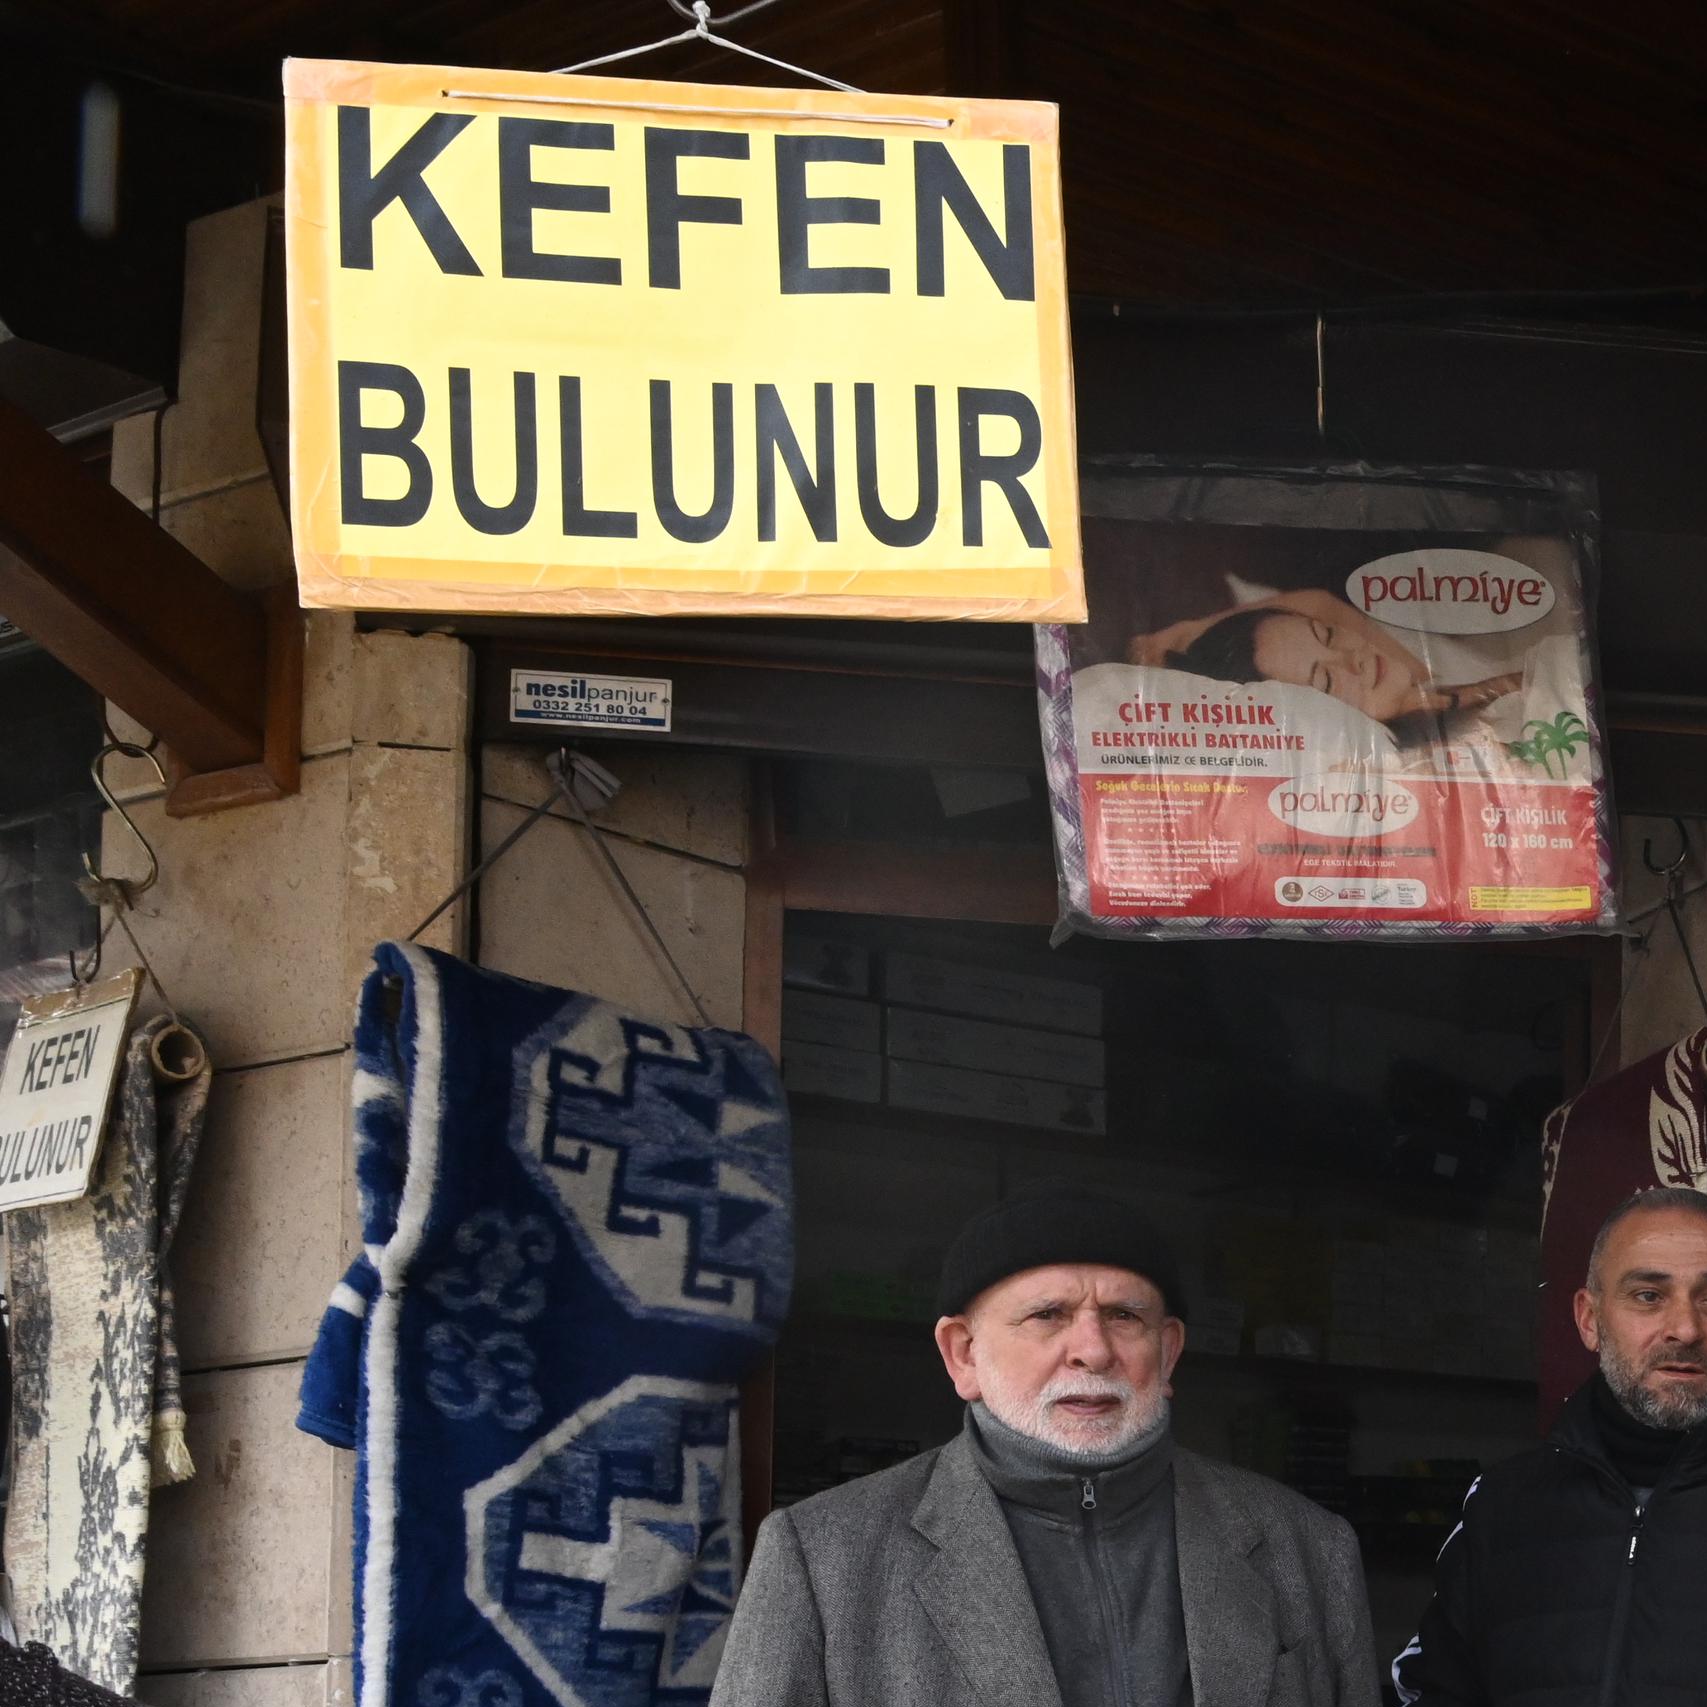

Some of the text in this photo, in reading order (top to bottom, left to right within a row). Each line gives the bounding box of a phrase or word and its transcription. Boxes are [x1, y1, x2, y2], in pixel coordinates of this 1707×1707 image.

[337, 105, 1035, 302] KEFEN
[337, 361, 1052, 550] BULUNUR
[1362, 567, 1543, 615] palmiye
[526, 679, 657, 705] nesilpanjur
[533, 699, 647, 716] 0332 251 80 04
[1118, 693, 1275, 728] ÇİFT KİŞİLİK
[1091, 725, 1305, 751] ELEKTRİKLİ BATTANİYE
[1101, 752, 1180, 766] ÜRÜNLERİMİZ
[1279, 786, 1409, 822] palmiye
[1483, 833, 1573, 849] 120 x 160 cm
[20, 1024, 101, 1095] KEFEN
[0, 1115, 92, 1186] ULUNUR
